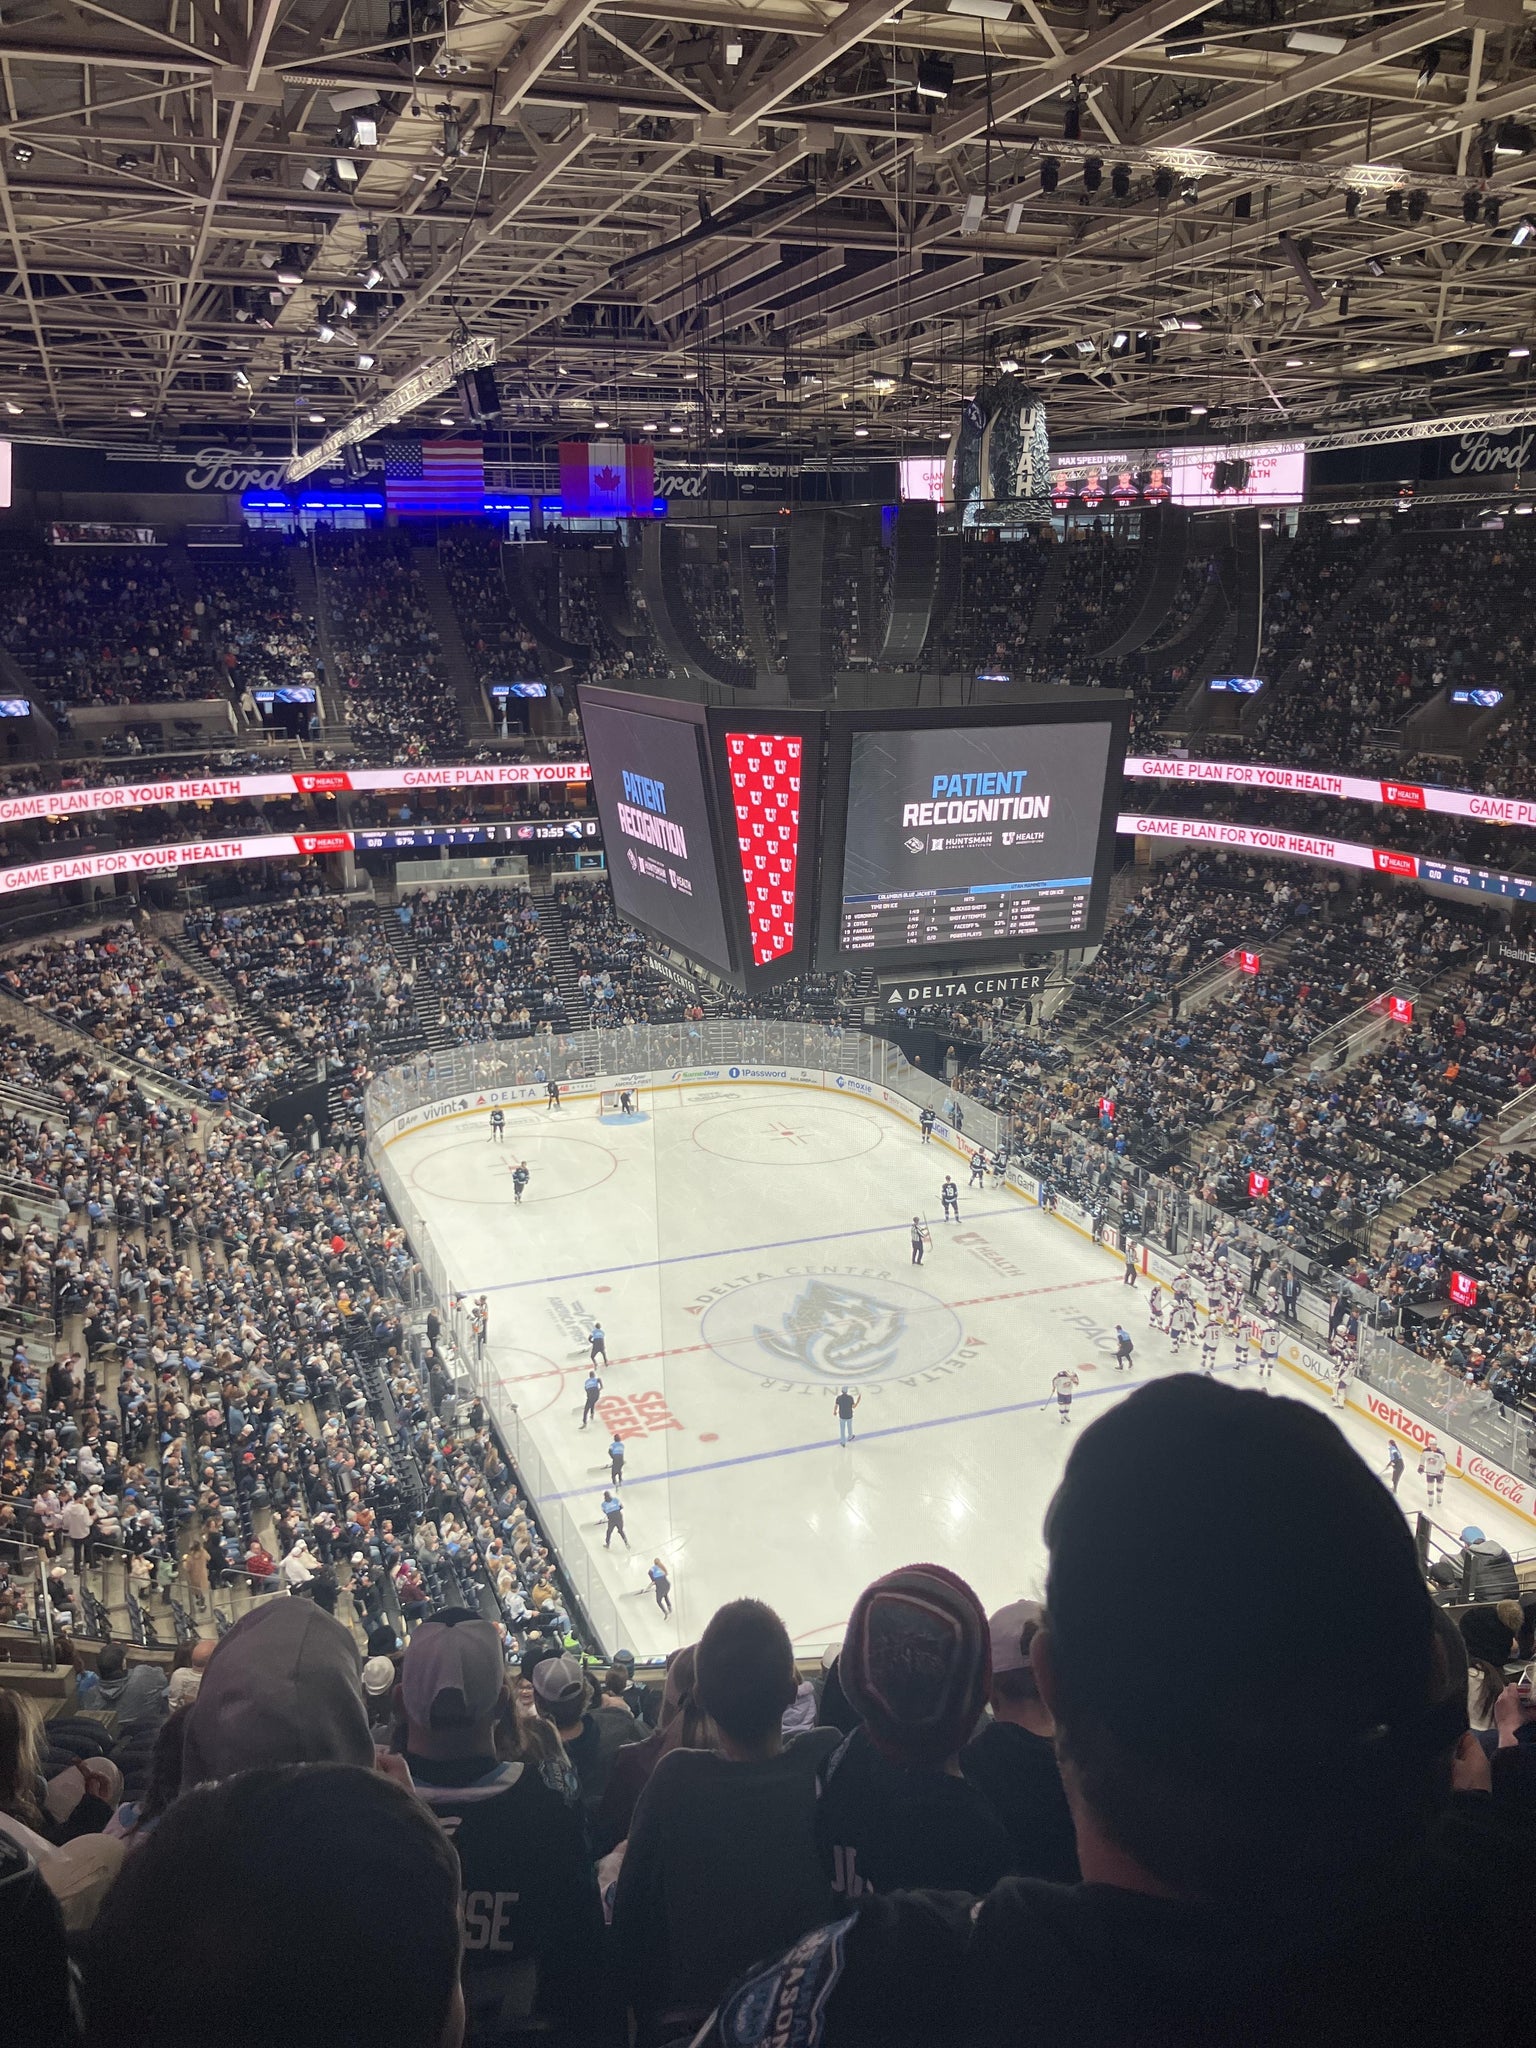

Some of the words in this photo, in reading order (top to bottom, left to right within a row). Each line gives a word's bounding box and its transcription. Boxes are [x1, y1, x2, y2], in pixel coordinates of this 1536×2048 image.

[1058, 457, 1075, 466] MAX
[1077, 455, 1103, 465] SPEED
[1451, 427, 1535, 474] Ford
[185, 447, 288, 490] Ford
[404, 769, 450, 785] GAME
[456, 768, 494, 783] PLAN
[500, 767, 529, 782] FOR
[533, 766, 575, 780] YOUR
[931, 770, 1028, 799] PATIENT
[1142, 761, 1184, 776] GAME
[1188, 764, 1223, 779] PLAN
[1226, 767, 1254, 782] FOR
[1257, 770, 1292, 787] YOUR
[1296, 774, 1342, 793] HEALTH
[1, 799, 45, 819] GAME
[50, 795, 92, 813] PLAN
[94, 790, 124, 807] FOR
[130, 785, 175, 803] YOUR
[180, 781, 241, 799] HEALTH
[622, 770, 666, 815] PATIENT
[902, 795, 1051, 828] RECOGNITION
[1469, 798, 1514, 819] GAME
[1518, 805, 1536, 823] PL
[617, 802, 688, 860] RECOGNITION
[945, 836, 993, 846] HUNTSMAN
[1016, 832, 1045, 841] HEALTH
[1136, 819, 1178, 835] GAME
[1182, 823, 1216, 839] PLAN
[1220, 828, 1246, 843] FOR
[1250, 831, 1286, 849] YOUR
[1289, 837, 1335, 858] HEALTH
[6, 870, 48, 888] GAME
[54, 863, 92, 879] PLAN
[99, 857, 127, 872] FOR
[133, 852, 177, 868] YOUR
[182, 843, 242, 862] HEALTH
[1453, 874, 1469, 886] 67%
[655, 962, 673, 980] DELTA
[673, 972, 697, 995] CENTER
[908, 983, 967, 1000] DELTA
[974, 976, 1040, 994] CENTER
[742, 1069, 787, 1078] 1Password
[847, 1080, 872, 1093] moxie
[490, 1088, 536, 1103] DELTA
[695, 1271, 770, 1304] DELTA
[785, 1265, 892, 1280] CENTER
[897, 1350, 979, 1387] DELTA
[594, 1395, 649, 1442] GEEK
[627, 1390, 686, 1432] SEAT
[463, 1890, 519, 1952] SE
